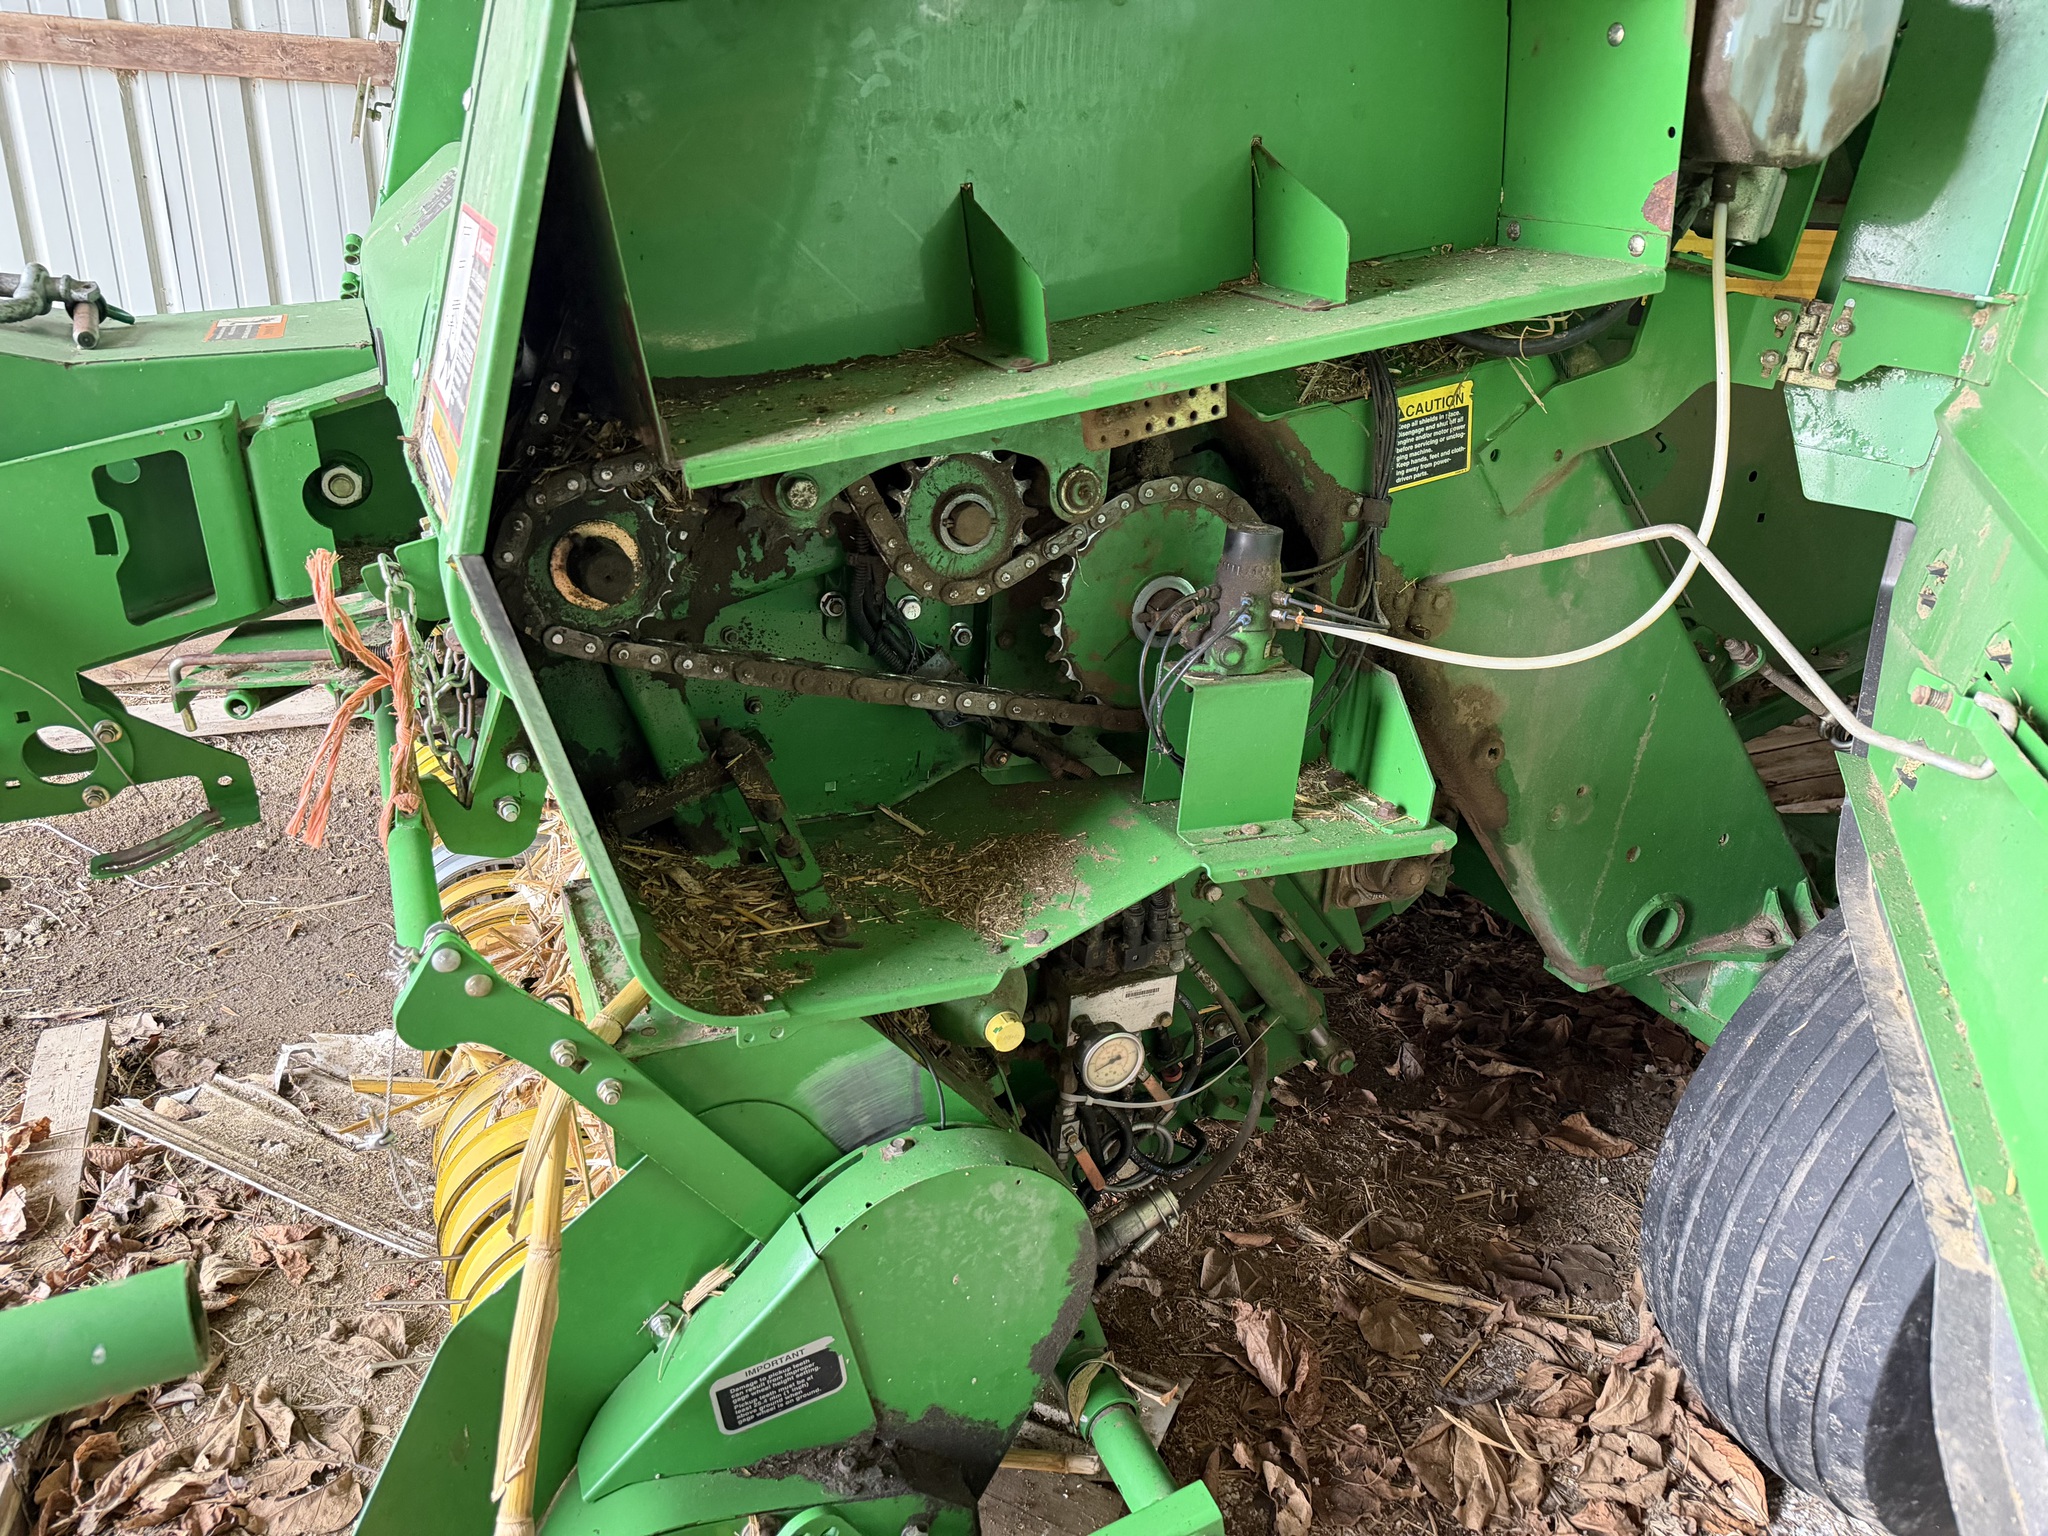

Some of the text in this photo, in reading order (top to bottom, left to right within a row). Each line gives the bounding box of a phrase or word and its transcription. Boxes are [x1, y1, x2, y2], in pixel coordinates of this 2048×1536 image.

[1405, 393, 1463, 417] CAUTION
[1418, 415, 1437, 425] shields
[1396, 445, 1413, 453] before
[1414, 438, 1438, 449] servicing
[1445, 431, 1465, 442] unclog-
[1415, 432, 1432, 441] and/or
[1395, 469, 1404, 477] ing
[1405, 466, 1419, 474] away
[1433, 458, 1451, 467] power-
[1396, 448, 1432, 462] ging machine.
[1396, 461, 1409, 469] Keep
[1410, 456, 1428, 465] hands,
[1451, 446, 1465, 454] cloth-
[1395, 471, 1428, 483] driven parts.
[729, 1380, 758, 1393] Damage
[767, 1366, 791, 1379] pickup
[792, 1359, 810, 1368] teeth
[744, 1349, 805, 1377] IMPORTANT
[732, 1365, 821, 1404] gage wheel height setting.
[745, 1382, 765, 1393] result
[766, 1375, 783, 1384] from
[784, 1362, 815, 1378] improper
[734, 1397, 758, 1411] Pickup
[758, 1390, 776, 1400] teeth
[777, 1383, 795, 1392] must
[735, 1405, 752, 1414] least
[753, 1399, 767, 1407] 25.4
[769, 1393, 781, 1401] mm
[791, 1382, 809, 1392] inch)
[736, 1390, 802, 1419] above ground when
[737, 1415, 755, 1425] gage
[755, 1406, 776, 1416] wheel
[795, 1387, 821, 1401] ground.
